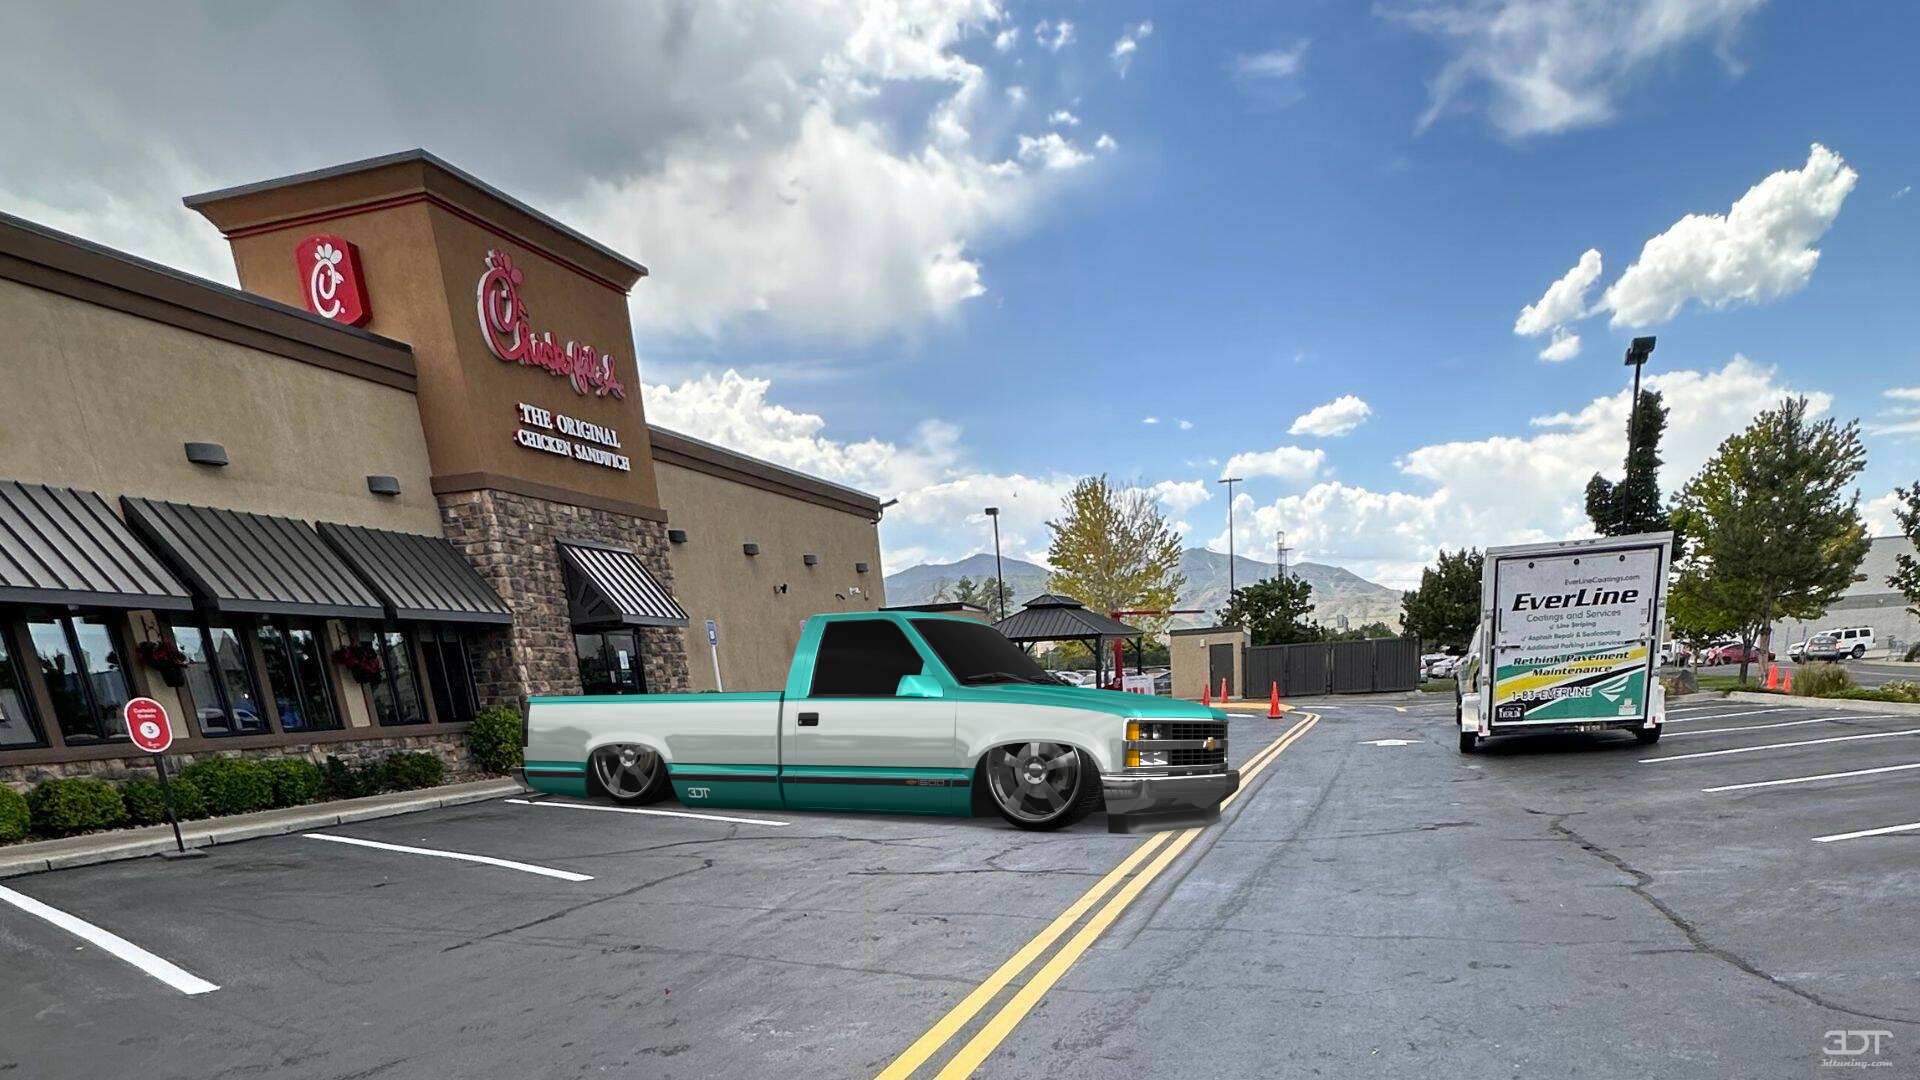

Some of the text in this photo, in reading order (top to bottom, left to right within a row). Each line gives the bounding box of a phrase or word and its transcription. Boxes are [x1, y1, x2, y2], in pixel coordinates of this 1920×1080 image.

[517, 402, 621, 449] THE ORIGINAL
[516, 429, 631, 472] CHICKEN SANDWICH
[1564, 574, 1640, 586] EverLineCoatings.com
[1511, 587, 1639, 612] EverLine
[1526, 608, 1621, 623] Coatings and Services
[1513, 651, 1630, 666] Rethink Pavement
[1531, 665, 1613, 677] Maintenance
[146, 725, 154, 734] 3
[687, 787, 711, 799] 3DT
